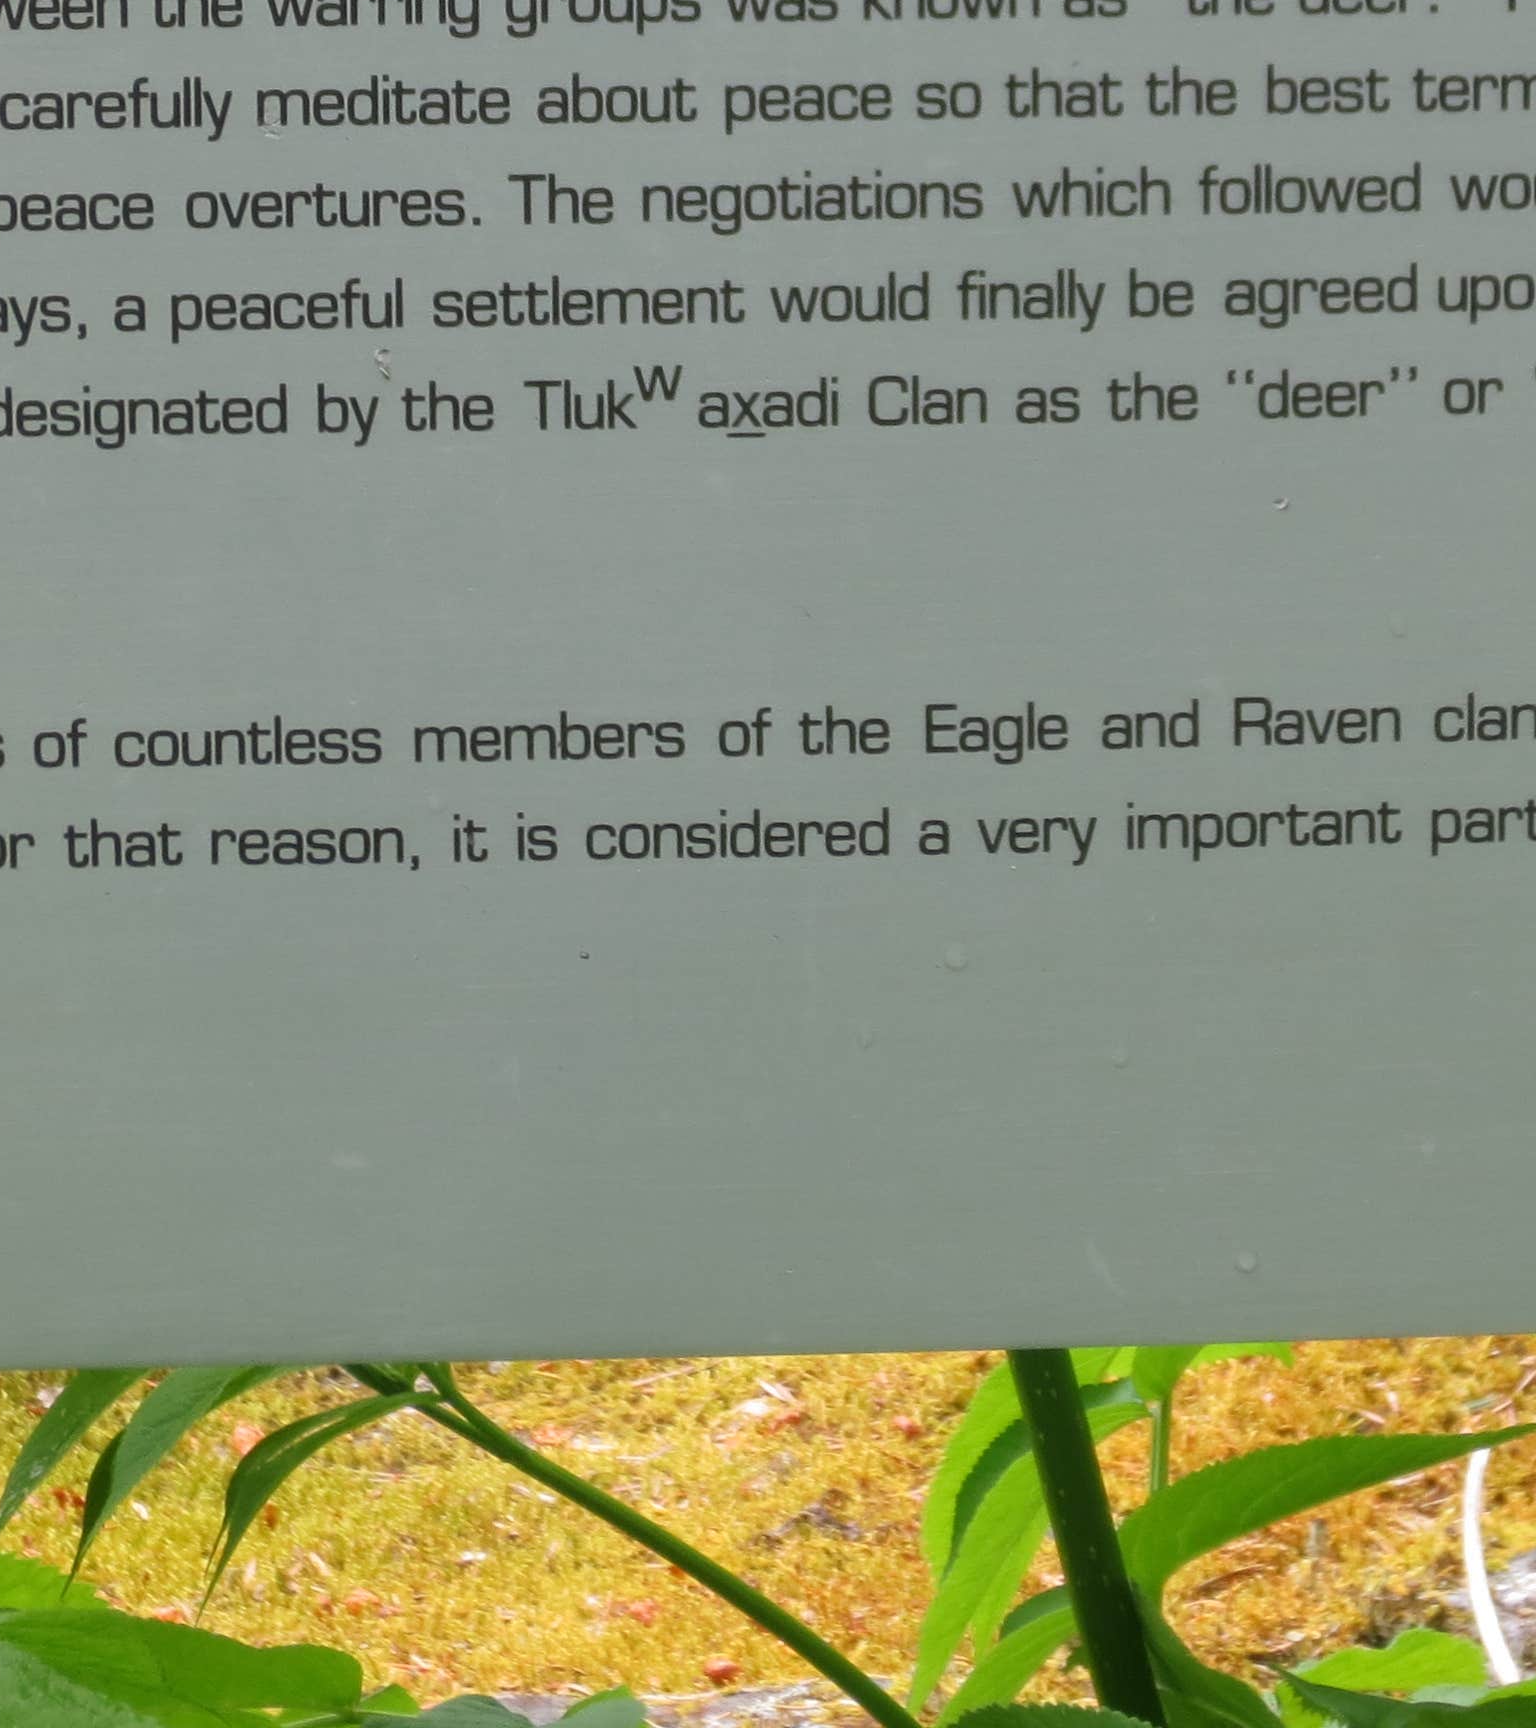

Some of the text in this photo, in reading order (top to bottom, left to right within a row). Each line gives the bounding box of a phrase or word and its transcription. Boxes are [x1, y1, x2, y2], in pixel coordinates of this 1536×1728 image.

[256, 74, 511, 127] meditate
[536, 71, 698, 125] about
[724, 83, 893, 136] peace
[916, 81, 983, 121] so
[1004, 66, 1124, 119] that
[1144, 64, 1238, 117] the
[1266, 63, 1391, 116] best
[113, 294, 147, 333] a
[170, 276, 404, 345] peaceful
[432, 274, 746, 329] settlement
[769, 270, 930, 323] would
[955, 267, 1106, 333] finally
[1128, 267, 1195, 318] be
[1224, 262, 1419, 330] agreed
[316, 382, 381, 449] by
[400, 380, 495, 433] the
[867, 374, 988, 427] Clan
[1015, 386, 1081, 425] as
[1106, 370, 1199, 423] the
[1226, 365, 1418, 420] “deer”
[1443, 377, 1504, 416] or
[33, 717, 89, 769] of
[114, 714, 383, 768] countless
[413, 710, 686, 763] members
[718, 706, 773, 758] of
[797, 704, 891, 756] the
[924, 701, 1069, 766] Eagle
[1101, 698, 1200, 751] and
[1233, 696, 1402, 747] Raven
[62, 817, 184, 869] that
[210, 826, 420, 872] reason,
[453, 813, 489, 863] it
[516, 811, 559, 862] is
[585, 806, 890, 861] considered
[918, 819, 951, 856] a
[976, 816, 1098, 867] very
[1126, 801, 1403, 863] important
